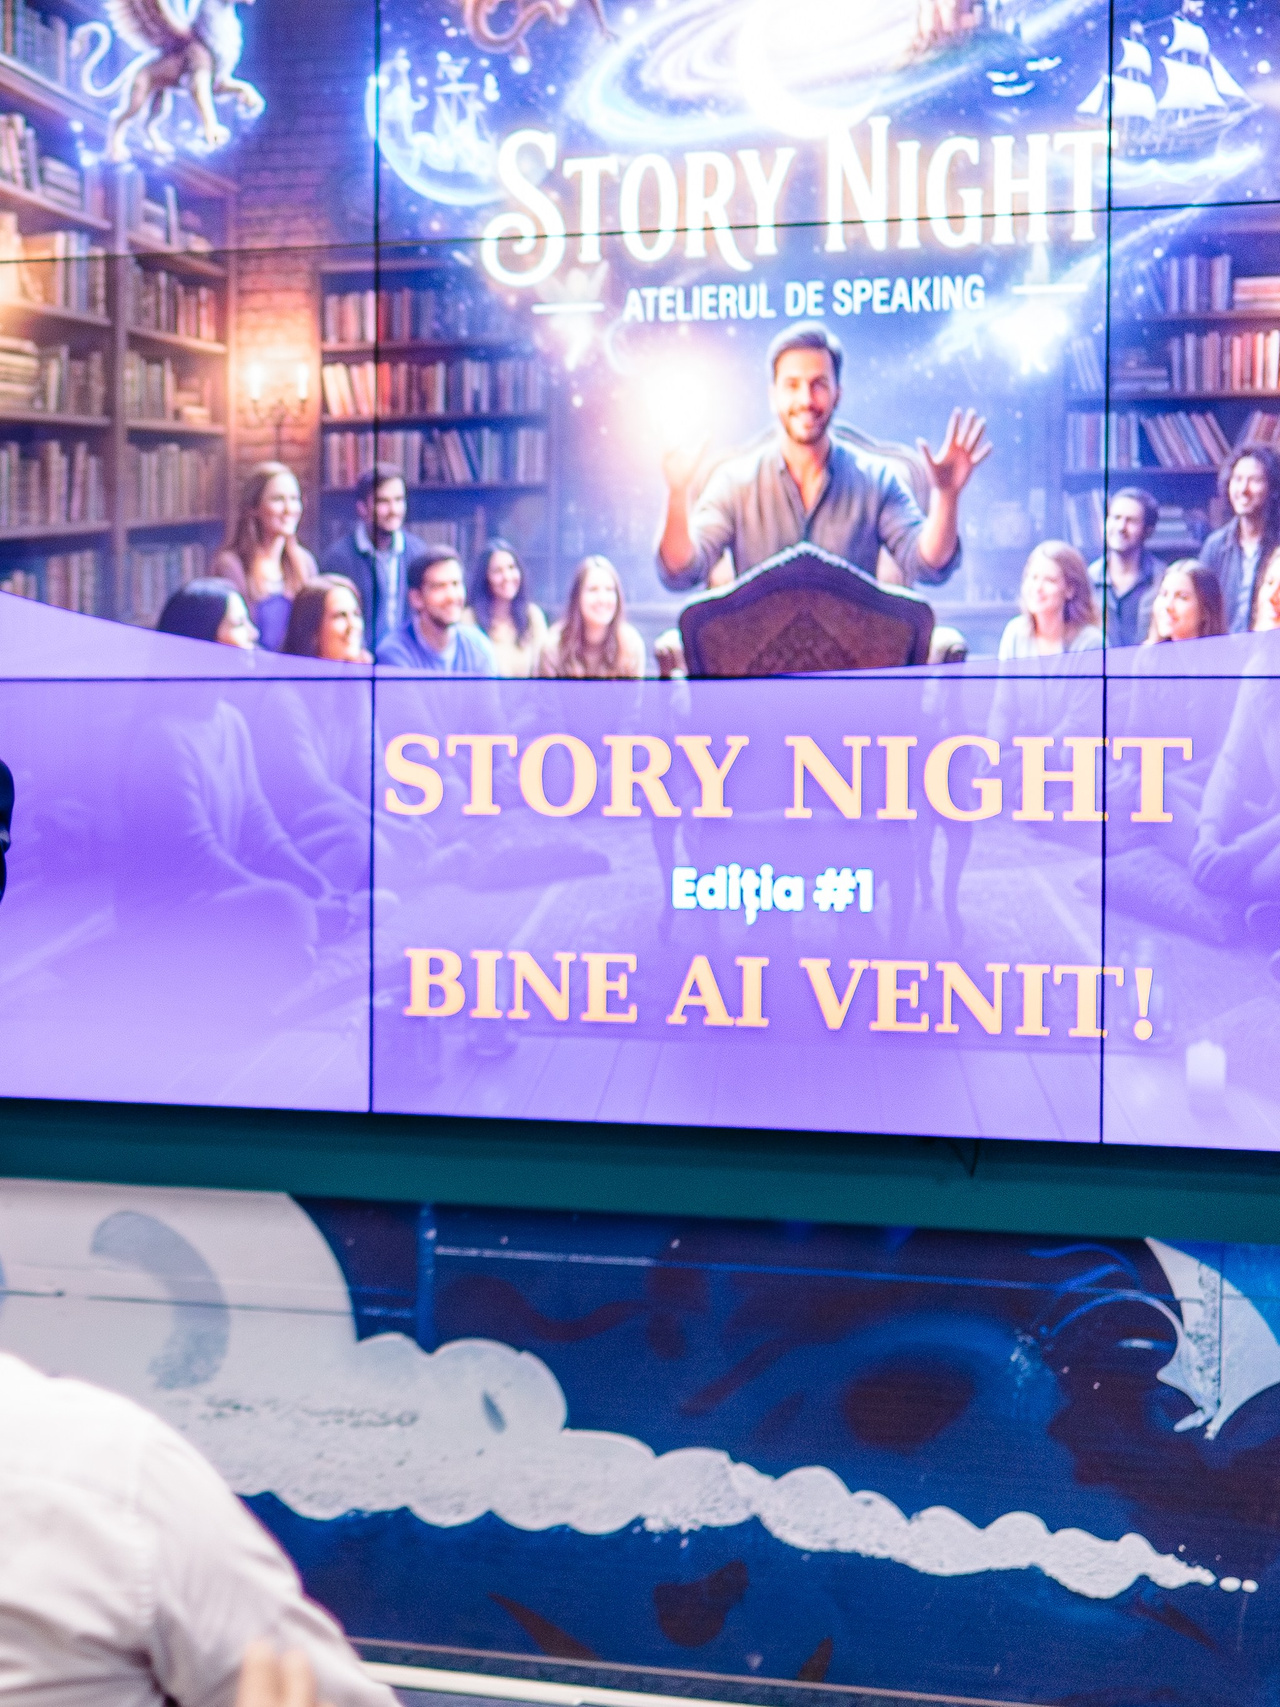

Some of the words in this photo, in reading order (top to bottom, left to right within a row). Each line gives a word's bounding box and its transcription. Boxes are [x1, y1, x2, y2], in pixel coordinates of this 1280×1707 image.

[480, 128, 796, 288] STORY
[823, 115, 1119, 253] NIGHT
[623, 281, 777, 323] ATELIERUL
[784, 279, 826, 318] DE
[831, 273, 986, 316] SPEAKING
[383, 733, 749, 819] STORY
[784, 734, 1194, 824] NIGHT
[671, 863, 805, 925] Ediția
[812, 867, 874, 913] #1
[403, 947, 638, 1023] BINE
[666, 954, 770, 1029] AI
[799, 956, 1156, 1041] VENIT!
